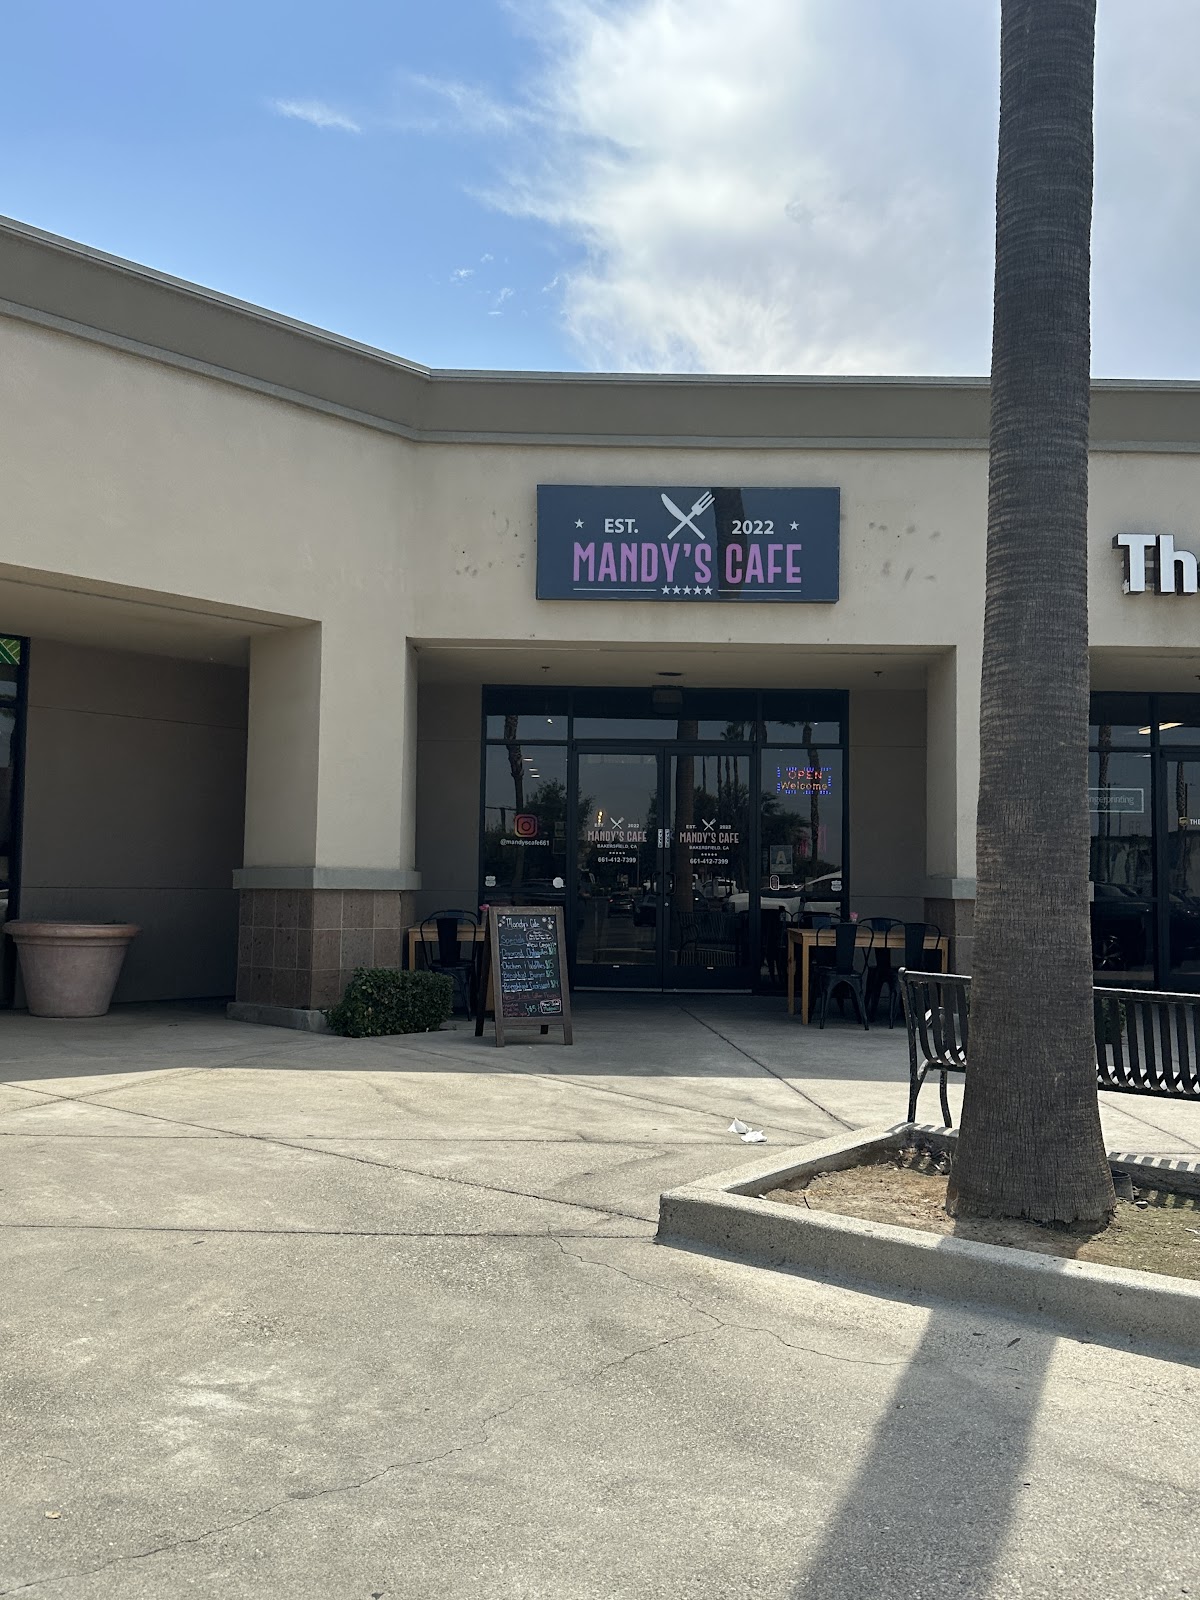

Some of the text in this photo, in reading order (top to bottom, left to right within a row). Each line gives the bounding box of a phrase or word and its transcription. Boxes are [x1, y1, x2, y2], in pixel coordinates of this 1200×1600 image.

[604, 518, 774, 535] EST. 2022
[572, 541, 802, 584] MANDY'S CAFE
[1111, 533, 1200, 596] Th
[788, 770, 823, 780] OPEN
[781, 781, 828, 791] Welcome
[1088, 794, 1135, 806] ngerprinting
[587, 830, 624, 842] MANDY'S
[627, 831, 648, 843] CAFE
[679, 832, 717, 844] MANDY'S
[719, 832, 740, 844] CAFE
[775, 850, 787, 864] A
